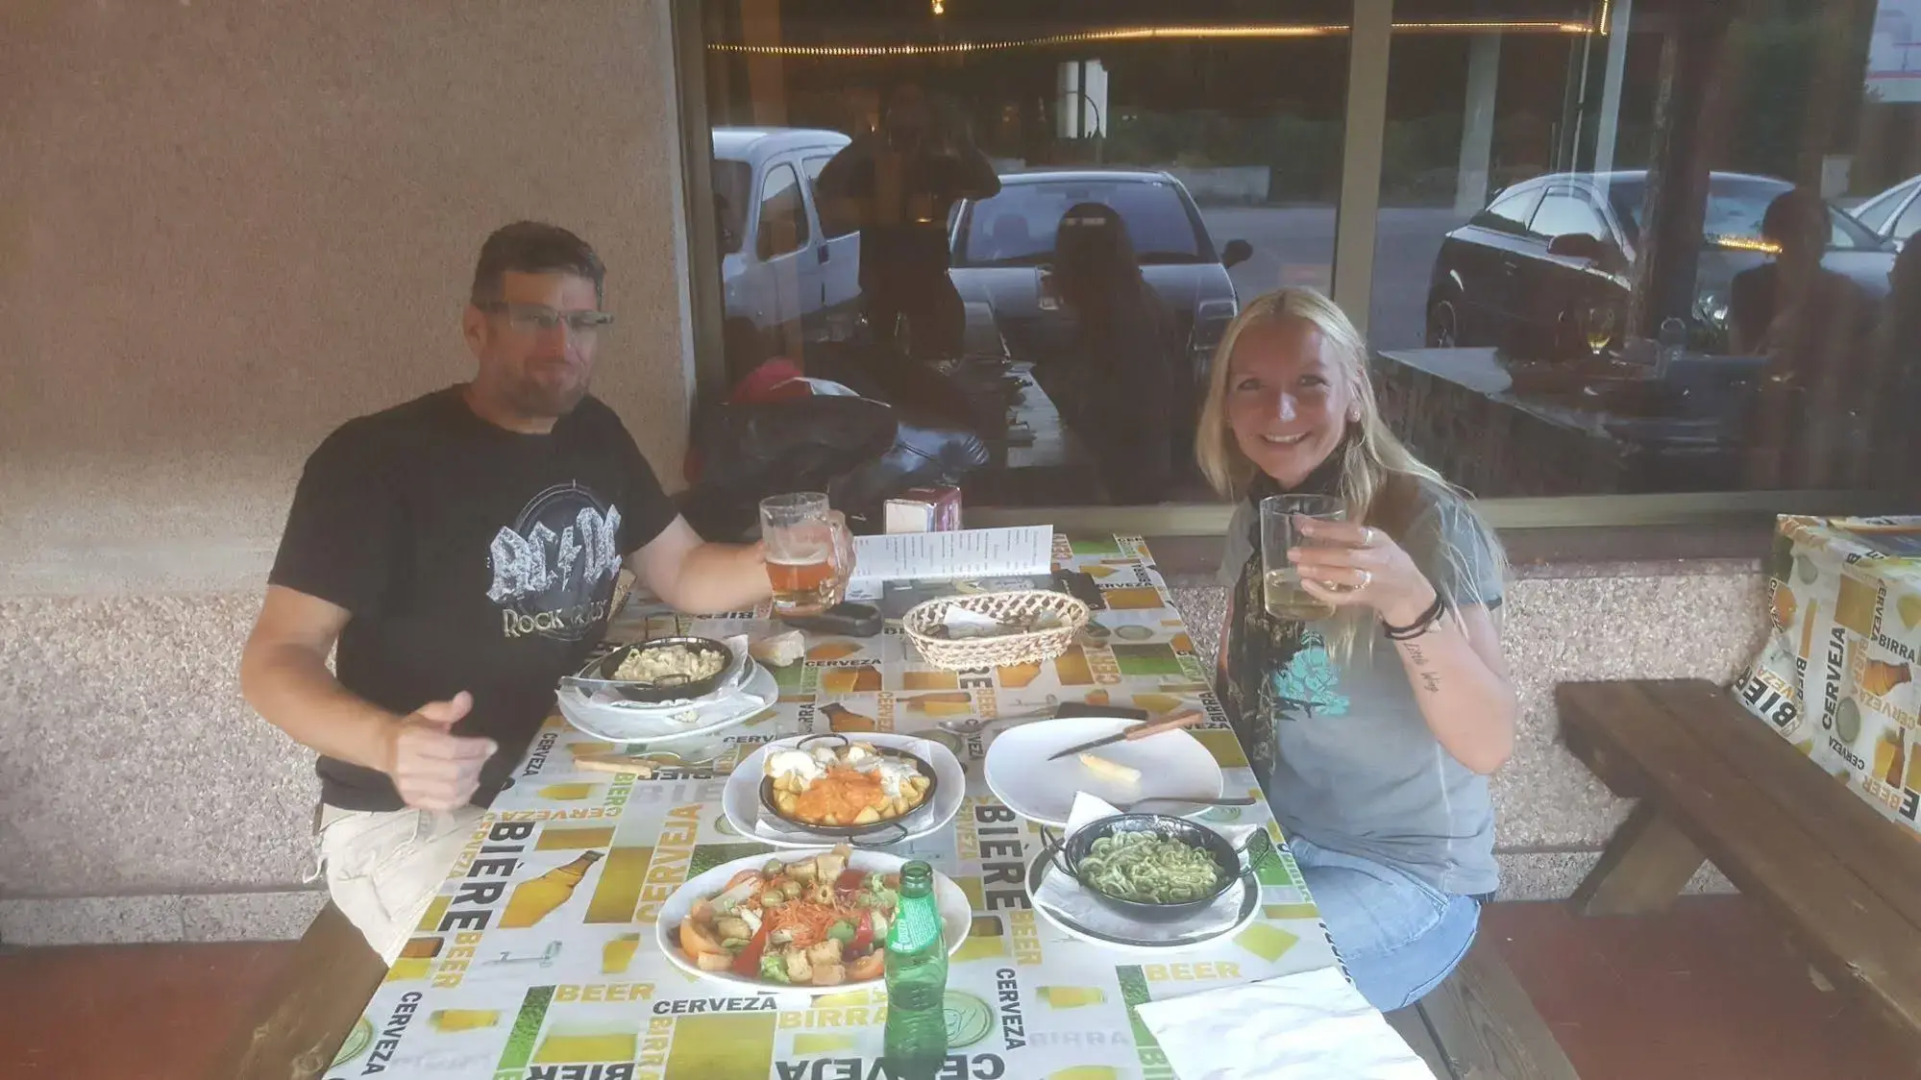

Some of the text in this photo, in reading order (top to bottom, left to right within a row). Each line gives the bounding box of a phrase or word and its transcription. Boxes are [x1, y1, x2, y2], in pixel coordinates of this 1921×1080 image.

[503, 608, 564, 637] ROCK
[1879, 634, 1915, 662] BIRRA
[1735, 664, 1797, 728] BIÈR
[1822, 628, 1845, 730] CERVEJA
[877, 692, 894, 732] CERVEZ
[1199, 692, 1227, 721] BIRRA
[1861, 692, 1916, 730] CERVEZA
[523, 733, 558, 776] CERVEZA
[723, 735, 775, 743] CERV
[1828, 736, 1865, 770] CERVEZA
[1862, 775, 1899, 809] BEER
[501, 807, 622, 822] CERVEZA
[634, 803, 701, 924] CERVEJA
[1010, 910, 1043, 965] BEER
[431, 931, 483, 988] BEER
[1144, 961, 1241, 982] BEER
[556, 983, 656, 1002] BEER
[653, 997, 777, 1015] CERVEZA
[996, 968, 1026, 1050] CERVEZA
[361, 991, 423, 1076] CERVEZA
[1029, 1031, 1131, 1046] BIRRA
[775, 1052, 1005, 1080] CEVEJA
